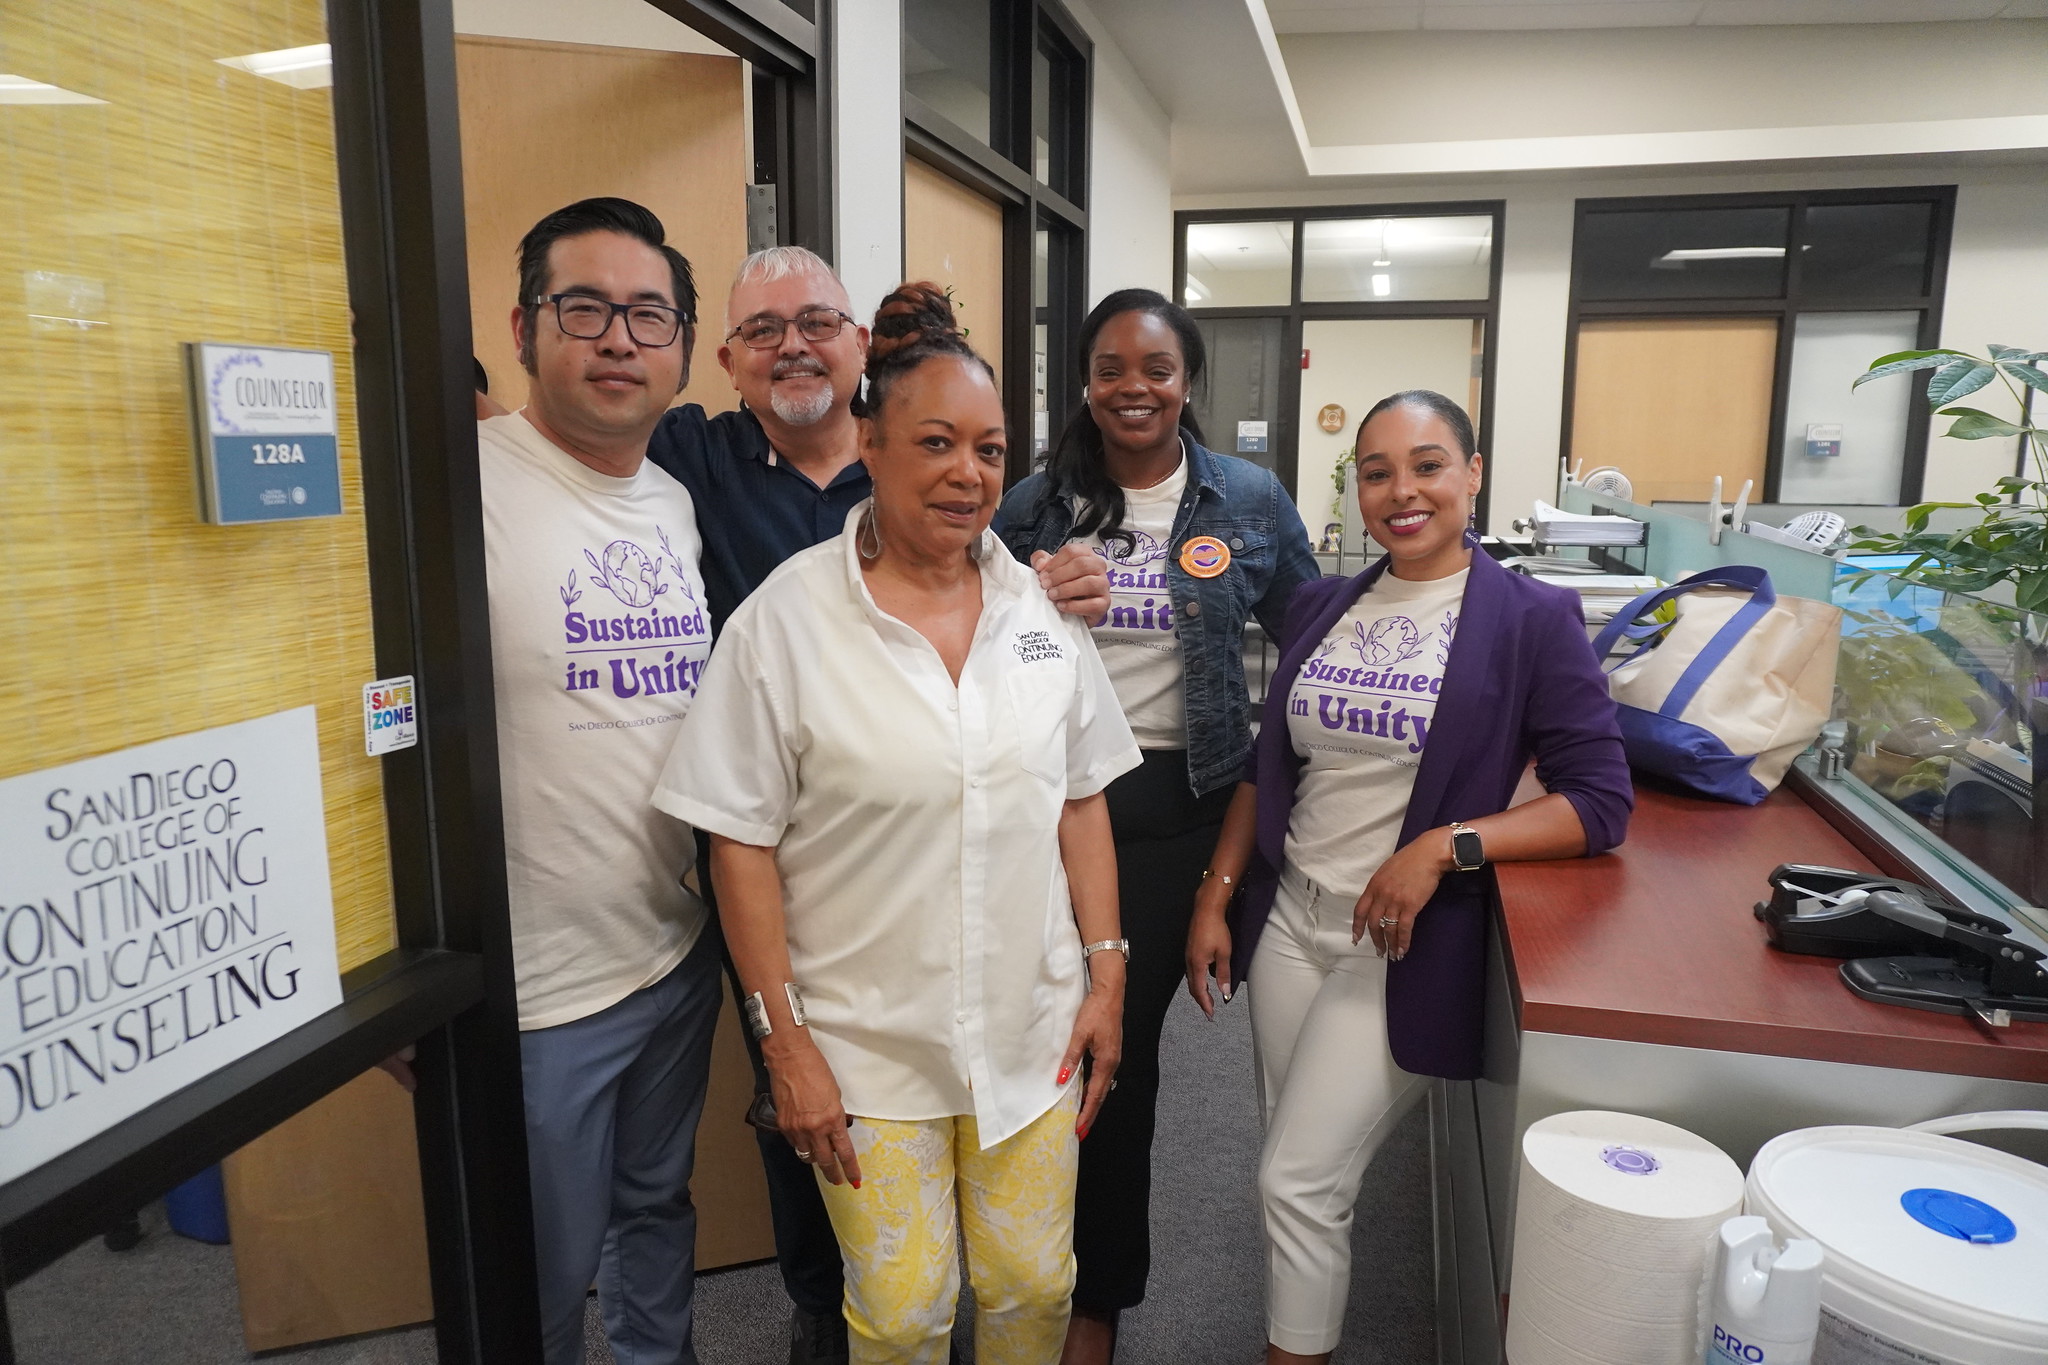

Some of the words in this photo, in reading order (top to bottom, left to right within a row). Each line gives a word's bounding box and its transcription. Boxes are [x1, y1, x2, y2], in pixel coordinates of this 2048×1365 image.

[235, 376, 328, 410] COUNSELOR
[252, 443, 306, 465] 128A
[564, 606, 705, 644] Sustained
[1013, 643, 1063, 655] CONTINUING
[1021, 651, 1063, 664] EDUCATION
[566, 662, 599, 691] in
[608, 650, 705, 699] Unity
[372, 686, 412, 710] SAFE
[372, 706, 414, 730] ZONE
[568, 722, 586, 731] SAN
[587, 721, 614, 730] DIEGO
[615, 719, 645, 729] COLLEGE
[1291, 691, 1309, 717] in
[1318, 693, 1432, 754] Unity
[1360, 749, 1396, 763] CONTINUING
[65, 809, 197, 877] COLLEGE
[204, 797, 242, 836] OF
[0, 827, 269, 978] ONTINUING
[14, 894, 259, 1034] EDUCATION
[0, 940, 302, 1131] OUNSELING
[1713, 1324, 1764, 1363] PRO
